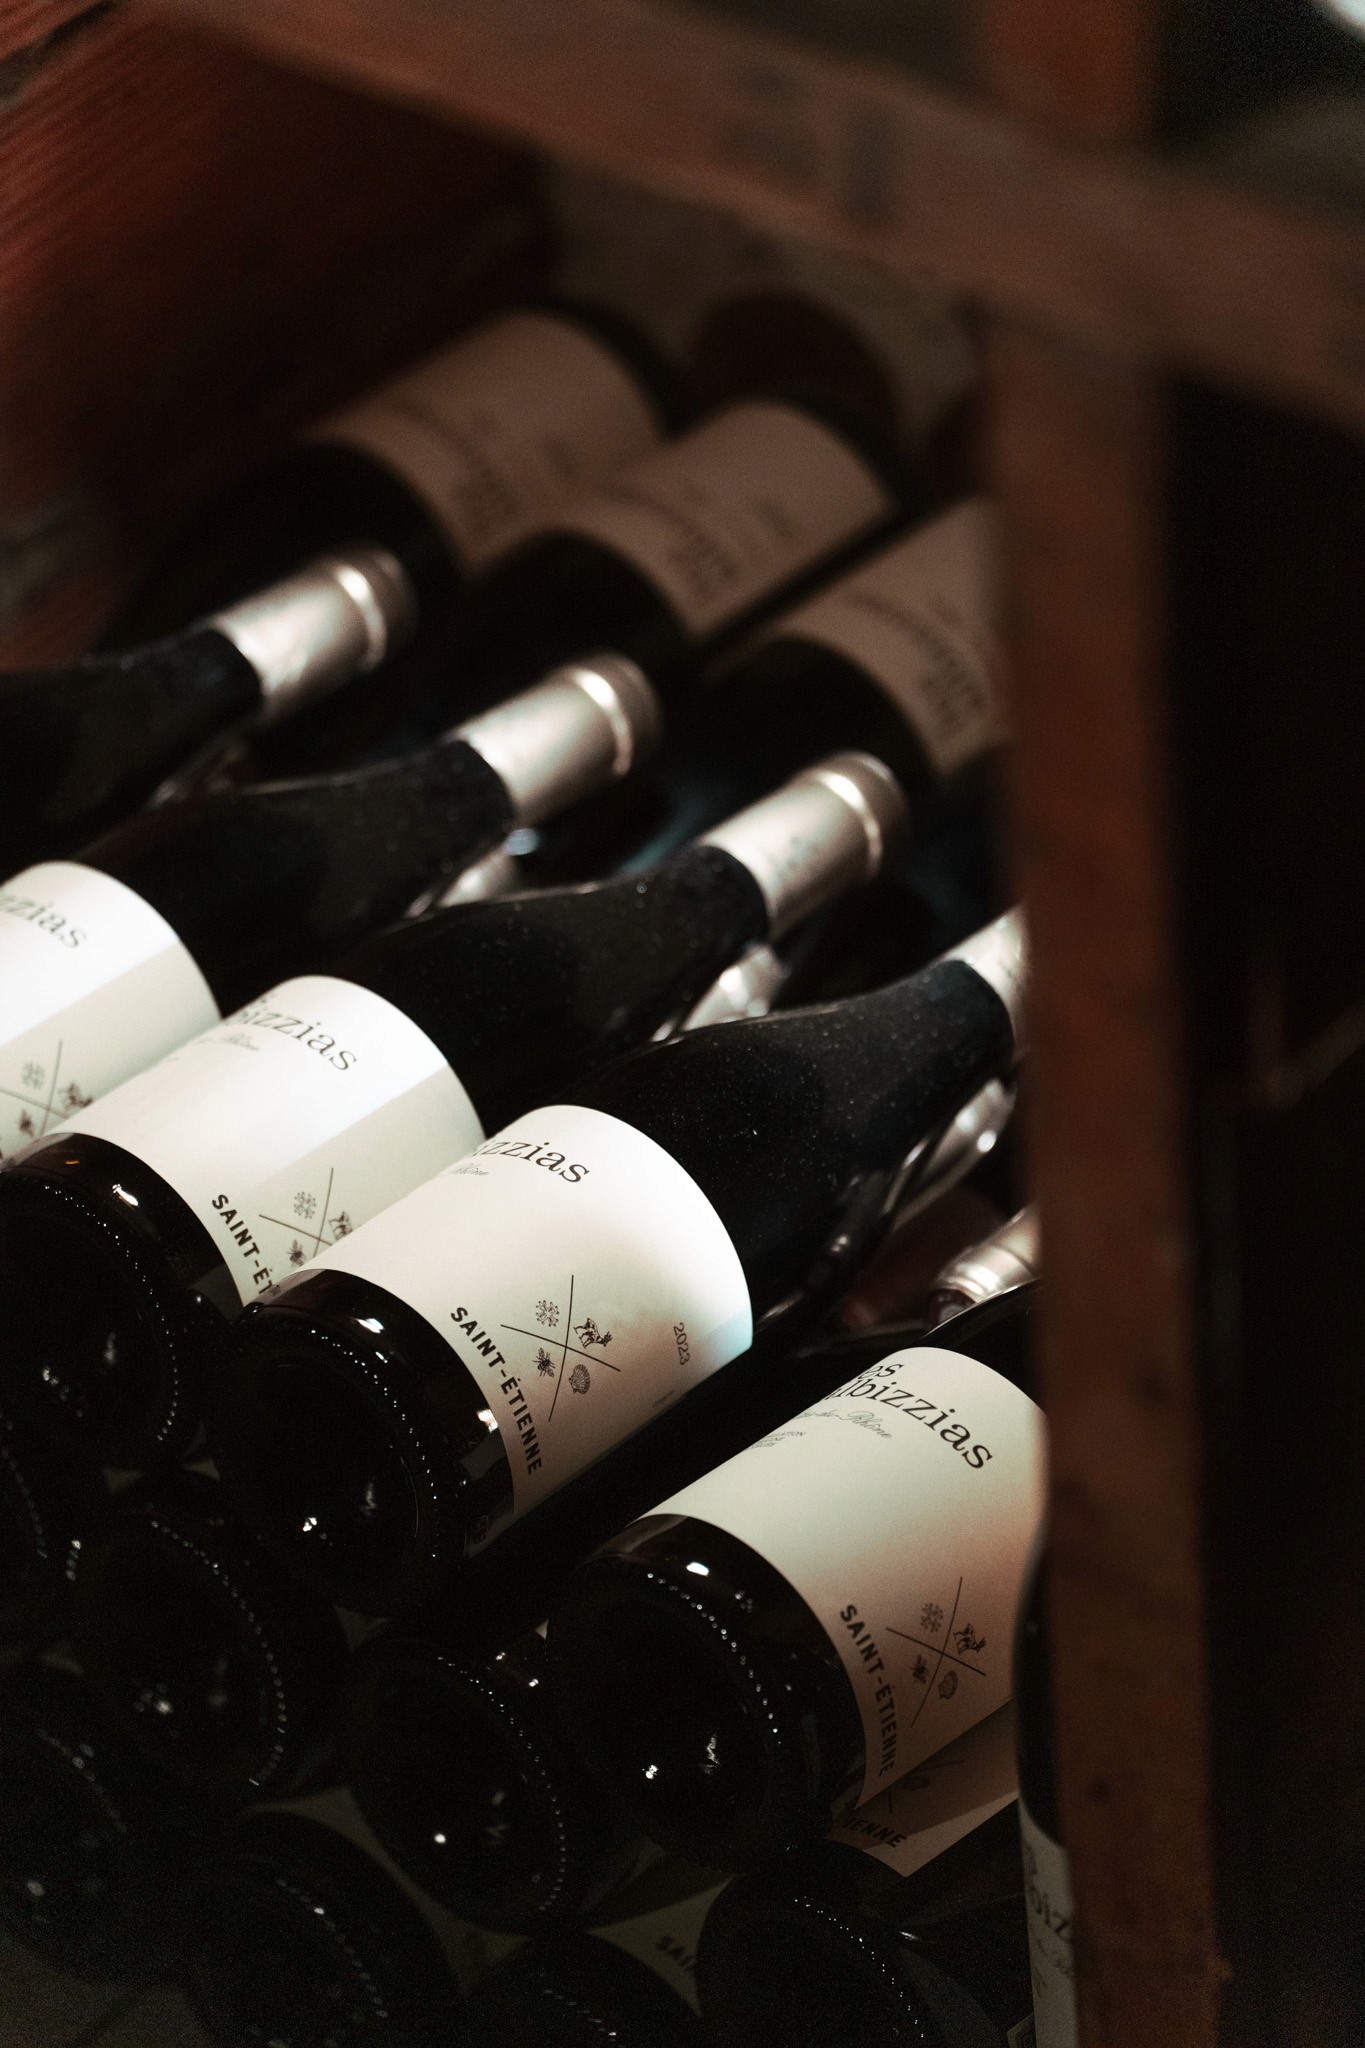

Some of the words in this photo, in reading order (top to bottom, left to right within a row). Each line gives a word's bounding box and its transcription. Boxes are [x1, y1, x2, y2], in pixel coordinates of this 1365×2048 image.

[450, 1306, 542, 1476] SAINT-ÉTIENNE
[673, 1322, 690, 1366] 2023
[840, 1604, 897, 1777] SAINT-ÉTIENNE
